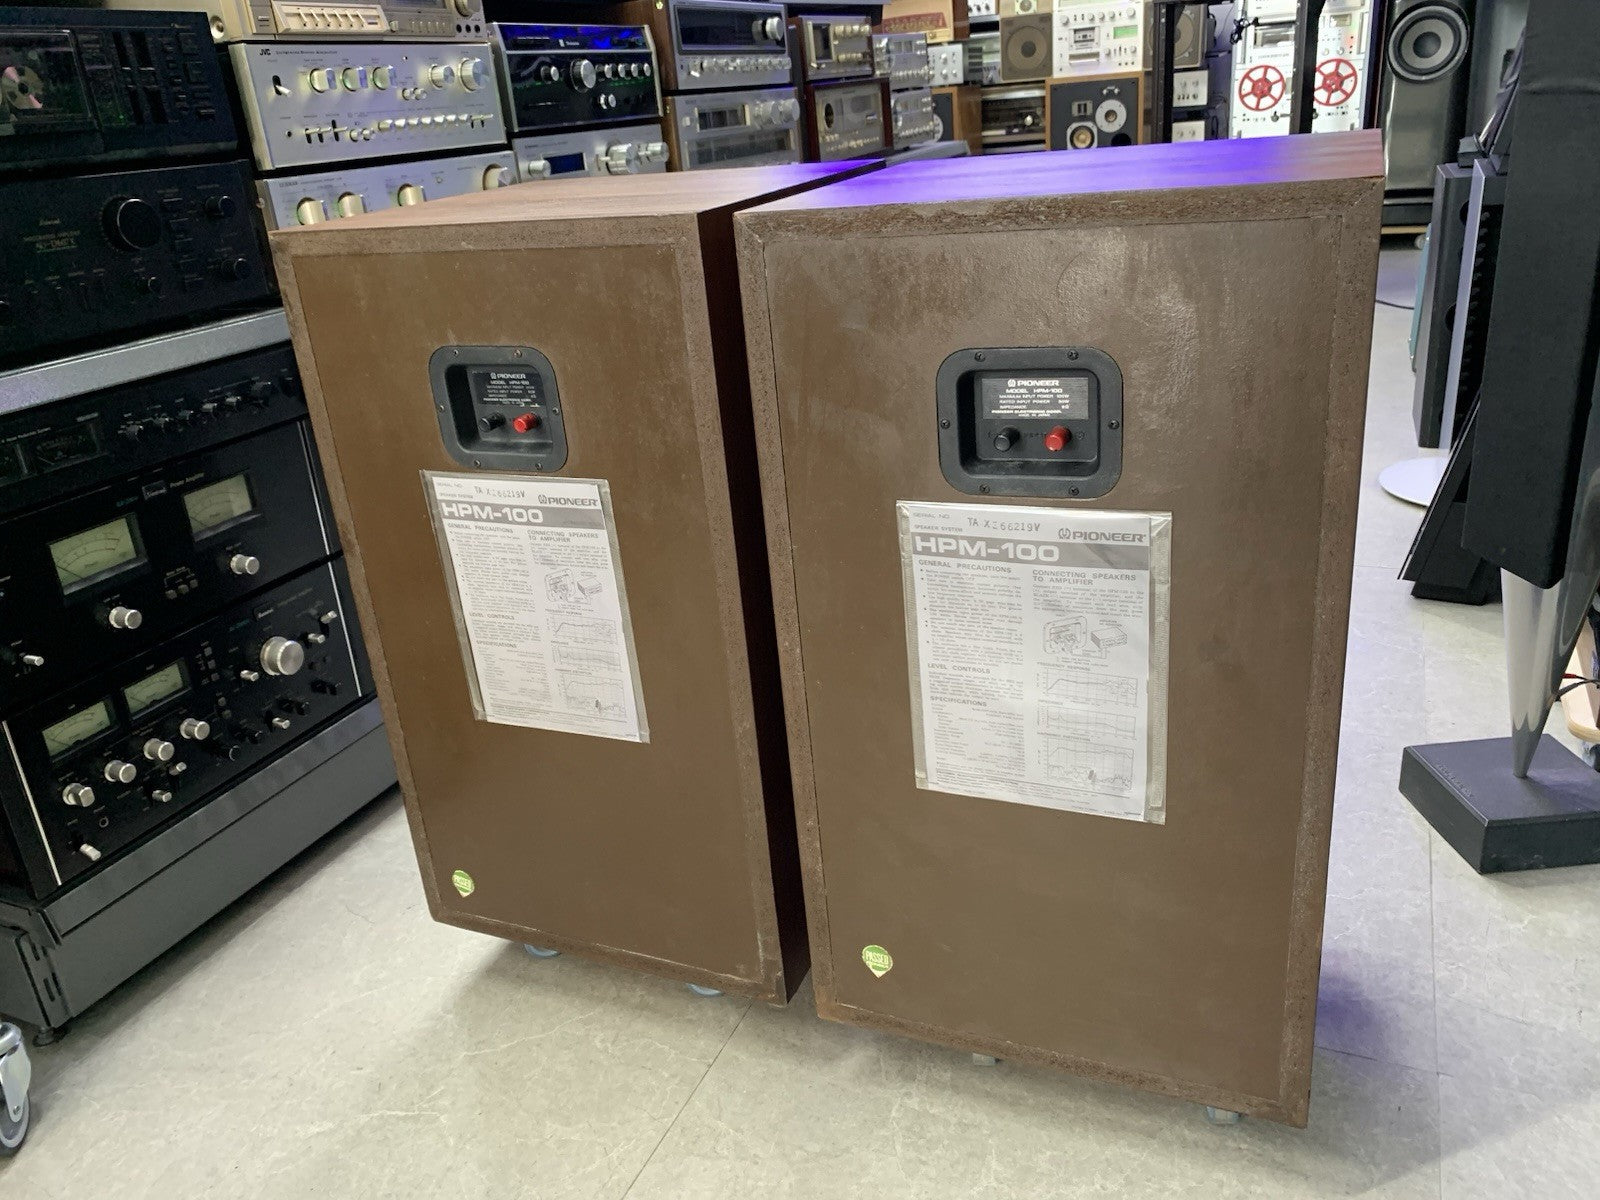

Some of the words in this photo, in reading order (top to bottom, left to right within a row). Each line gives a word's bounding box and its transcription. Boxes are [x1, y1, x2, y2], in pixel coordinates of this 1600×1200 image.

[260, 48, 271, 56] JVC
[1016, 379, 1060, 387] PIONEER
[548, 497, 597, 507] PIONEER
[441, 502, 544, 524] HPM-100
[968, 517, 979, 527] TA
[1072, 531, 1145, 543] PIONEER
[914, 535, 1060, 562] HPM-100
[918, 559, 951, 568] GENERAL
[956, 563, 1012, 574] PRECAUTIONS
[1032, 569, 1086, 579] CONNECTING
[1092, 573, 1137, 581] SPEAKERS
[1049, 577, 1093, 586] AMPLIFIER
[927, 662, 948, 670] LEVEL
[952, 664, 991, 674] CONTROLS
[929, 695, 988, 707] SPECIFICATIONS
